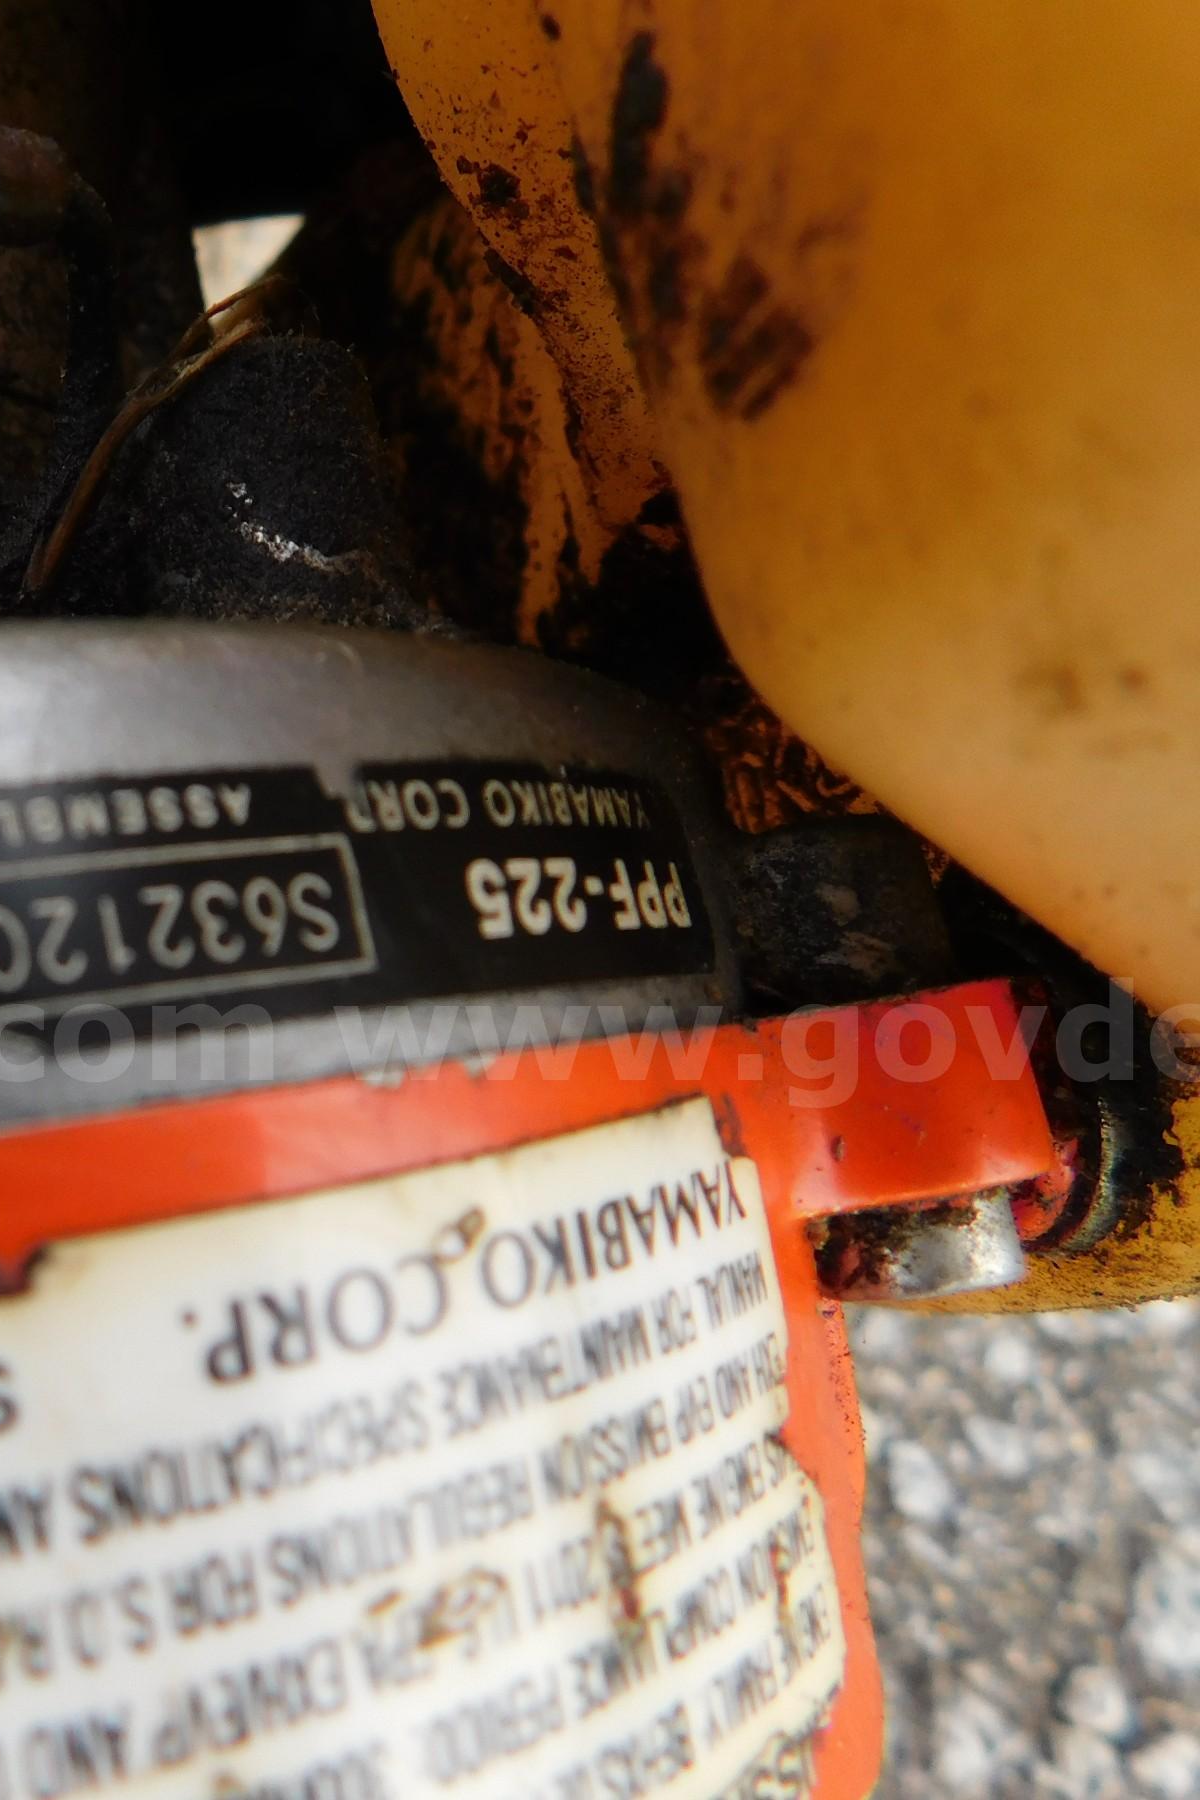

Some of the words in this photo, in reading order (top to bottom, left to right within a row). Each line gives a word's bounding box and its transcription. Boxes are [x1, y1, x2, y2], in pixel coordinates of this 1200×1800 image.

[481, 778, 651, 829] YAMABIKO
[464, 857, 692, 941] PPF-225
[479, 1160, 746, 1311] YAMABIKO
[697, 1250, 768, 1332] MANUAL
[176, 1255, 448, 1389] CORP.
[435, 1304, 651, 1441] MAINTENANCE
[653, 1288, 697, 1357] FOR
[67, 1380, 428, 1550] SPECIFICATIONS
[263, 1455, 533, 1613] REGULATIONS
[159, 1547, 261, 1642] FOR
